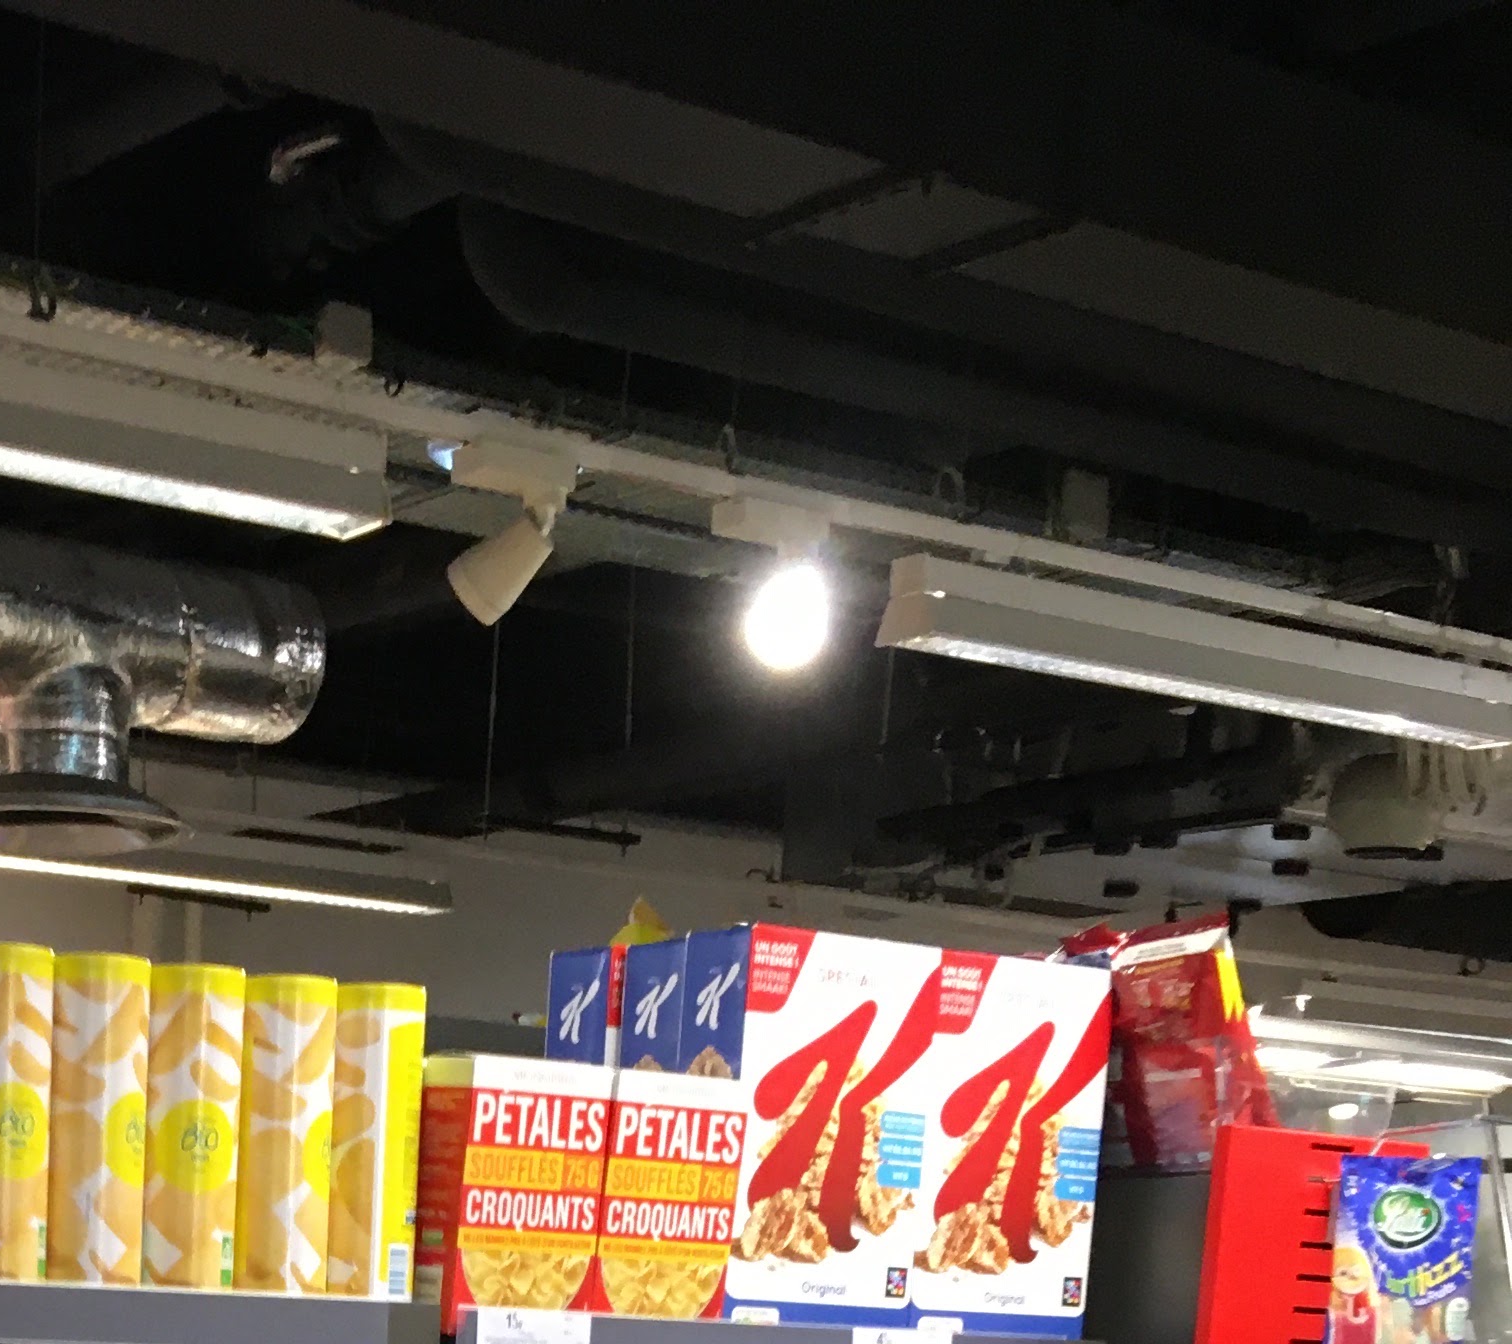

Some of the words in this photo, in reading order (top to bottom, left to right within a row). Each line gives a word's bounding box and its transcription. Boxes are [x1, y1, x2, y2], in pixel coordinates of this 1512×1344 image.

[559, 978, 601, 1044] K
[635, 973, 679, 1039] K
[696, 963, 740, 1031] K
[473, 1088, 606, 1153] PÉTALES
[616, 1103, 743, 1164] PÉTALES
[466, 1189, 596, 1232] CROQUANTS
[607, 1201, 731, 1242] CROQUANTS
[801, 1280, 846, 1298] Original
